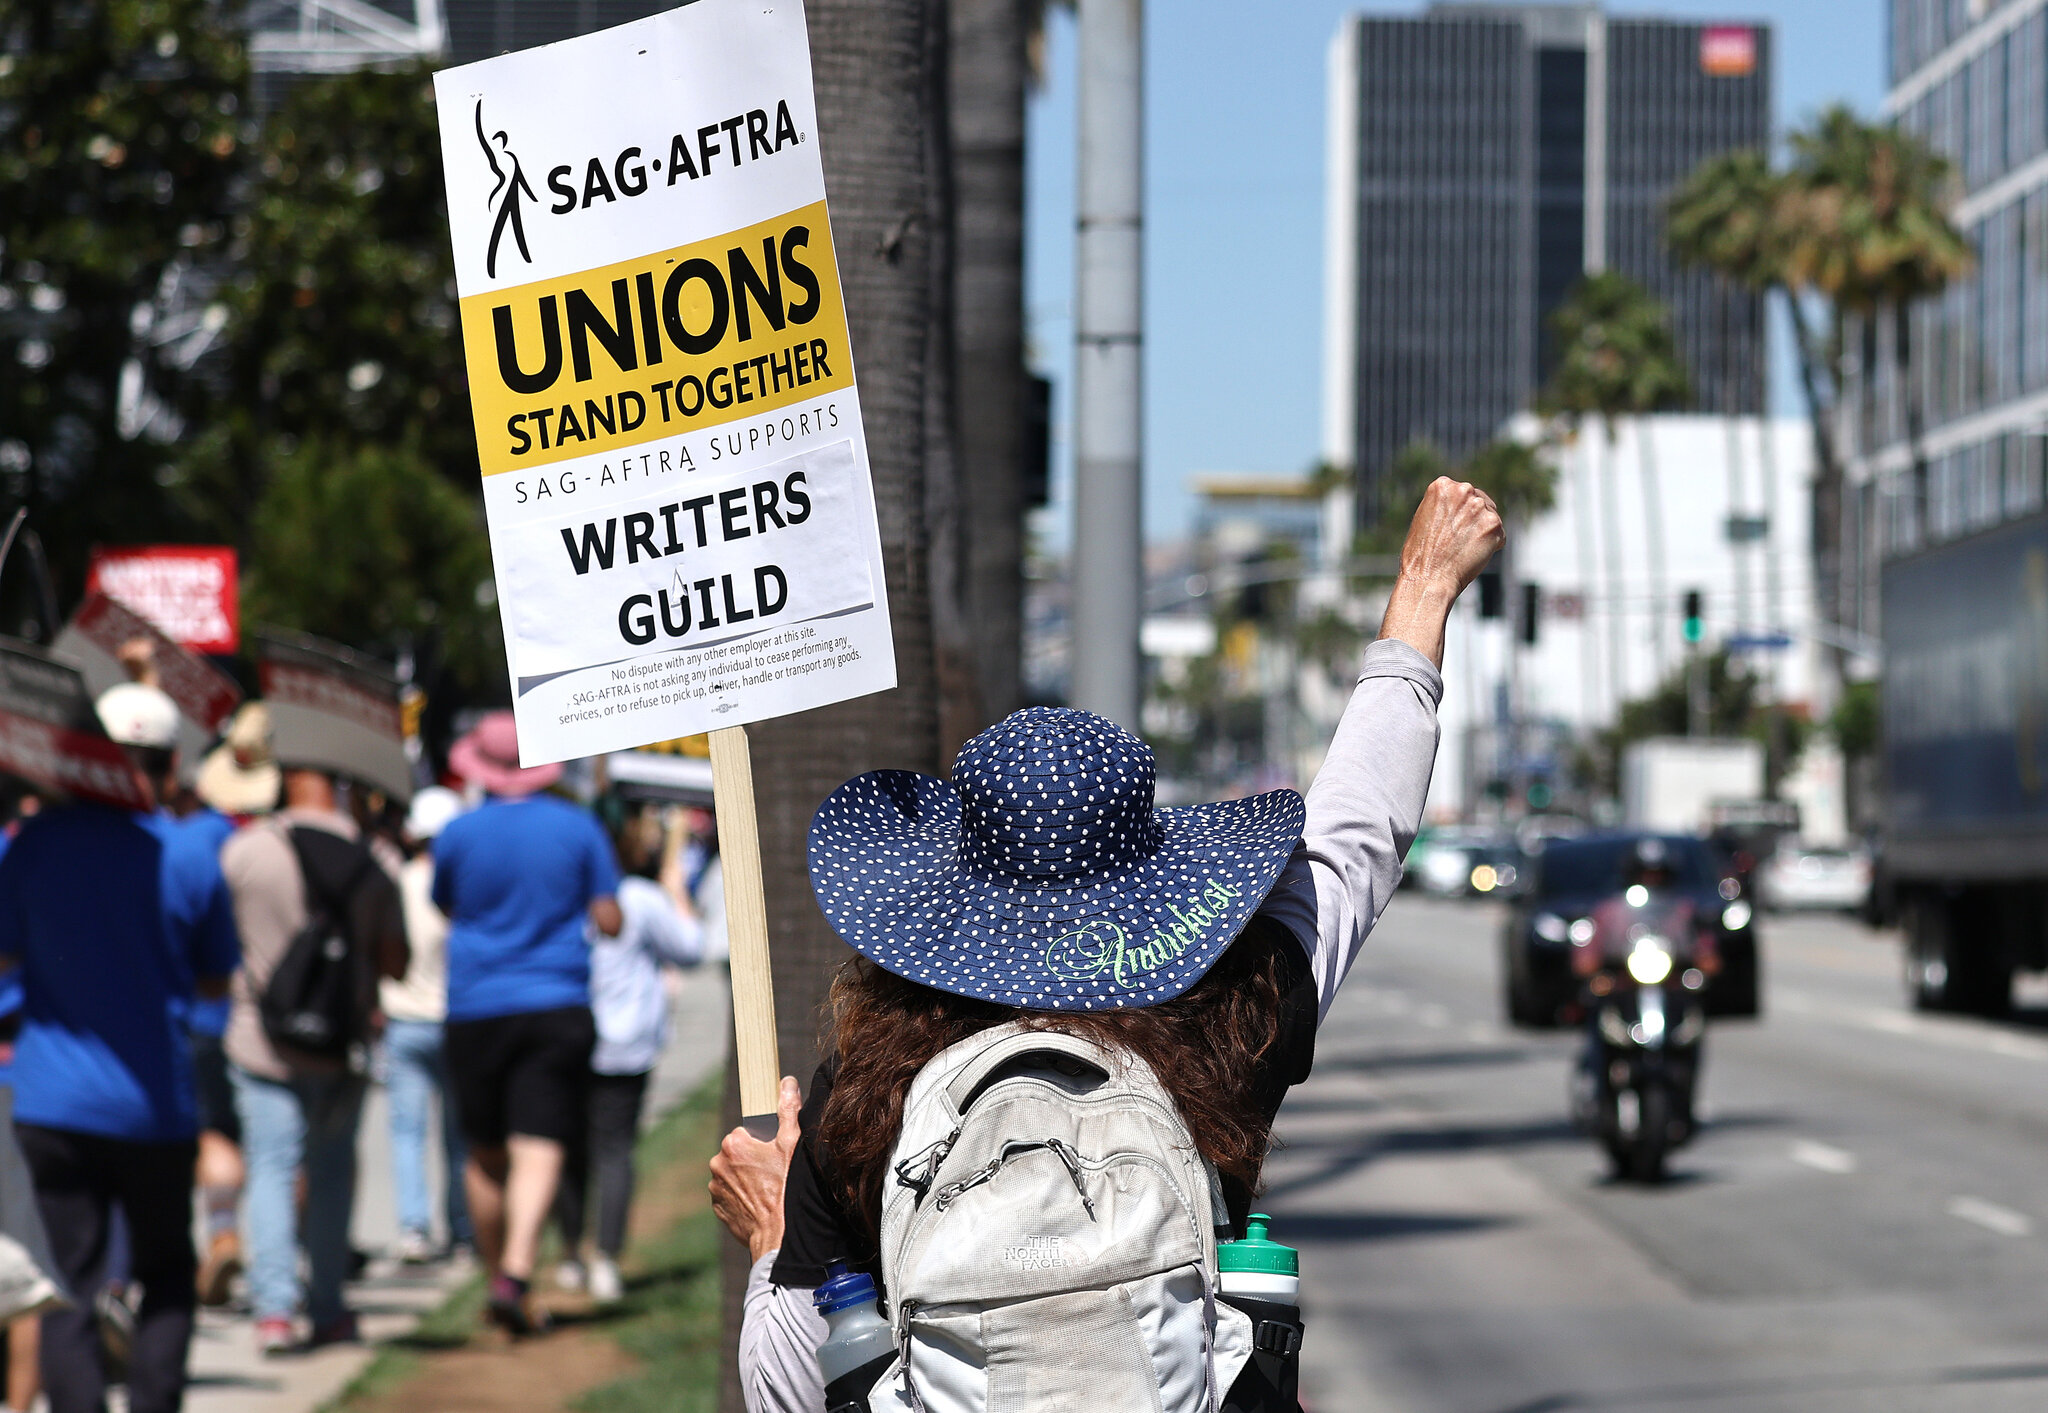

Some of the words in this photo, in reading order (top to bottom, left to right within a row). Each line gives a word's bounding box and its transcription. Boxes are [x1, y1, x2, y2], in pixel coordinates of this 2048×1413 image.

[491, 225, 821, 394] UNIONS
[507, 390, 646, 456] STAND
[651, 338, 833, 423] TOGETHER
[515, 445, 694, 503] SAG-AFTRA
[710, 403, 839, 460] SUPPORTS
[560, 471, 812, 576] WRITERS
[618, 564, 788, 646] GUILD
[559, 708, 602, 725] services,
[604, 704, 615, 716] or
[617, 703, 628, 714] to
[629, 696, 659, 711] refuse
[660, 693, 671, 705] to
[673, 686, 691, 705] pick
[693, 686, 707, 702] up,
[708, 678, 741, 695] deliver,
[742, 669, 773, 687] handle
[774, 668, 785, 681] or
[785, 659, 822, 677] transport
[823, 655, 837, 670] any
[837, 648, 862, 667] goods.
[572, 684, 631, 706] SAG-AFTRA
[633, 682, 641, 693] is
[643, 679, 659, 692] not
[661, 671, 690, 688] asking
[691, 668, 707, 682] any
[708, 656, 753, 678] individual
[754, 655, 765, 667] to
[766, 651, 790, 665] cease
[791, 638, 834, 662] performing
[834, 635, 848, 650] any
[611, 669, 626, 681] No
[628, 661, 663, 679] dispute
[665, 655, 685, 669] with
[686, 655, 702, 666] any
[703, 647, 728, 661] other
[730, 637, 773, 656] employer
[773, 634, 783, 646] at
[784, 630, 799, 644] this
[800, 626, 817, 640] site.
[1046, 878, 1239, 989] Anarchist
[1004, 1247, 1061, 1260] NORTH
[1021, 1259, 1062, 1271] FACE
[1028, 1235, 1060, 1249] THE
